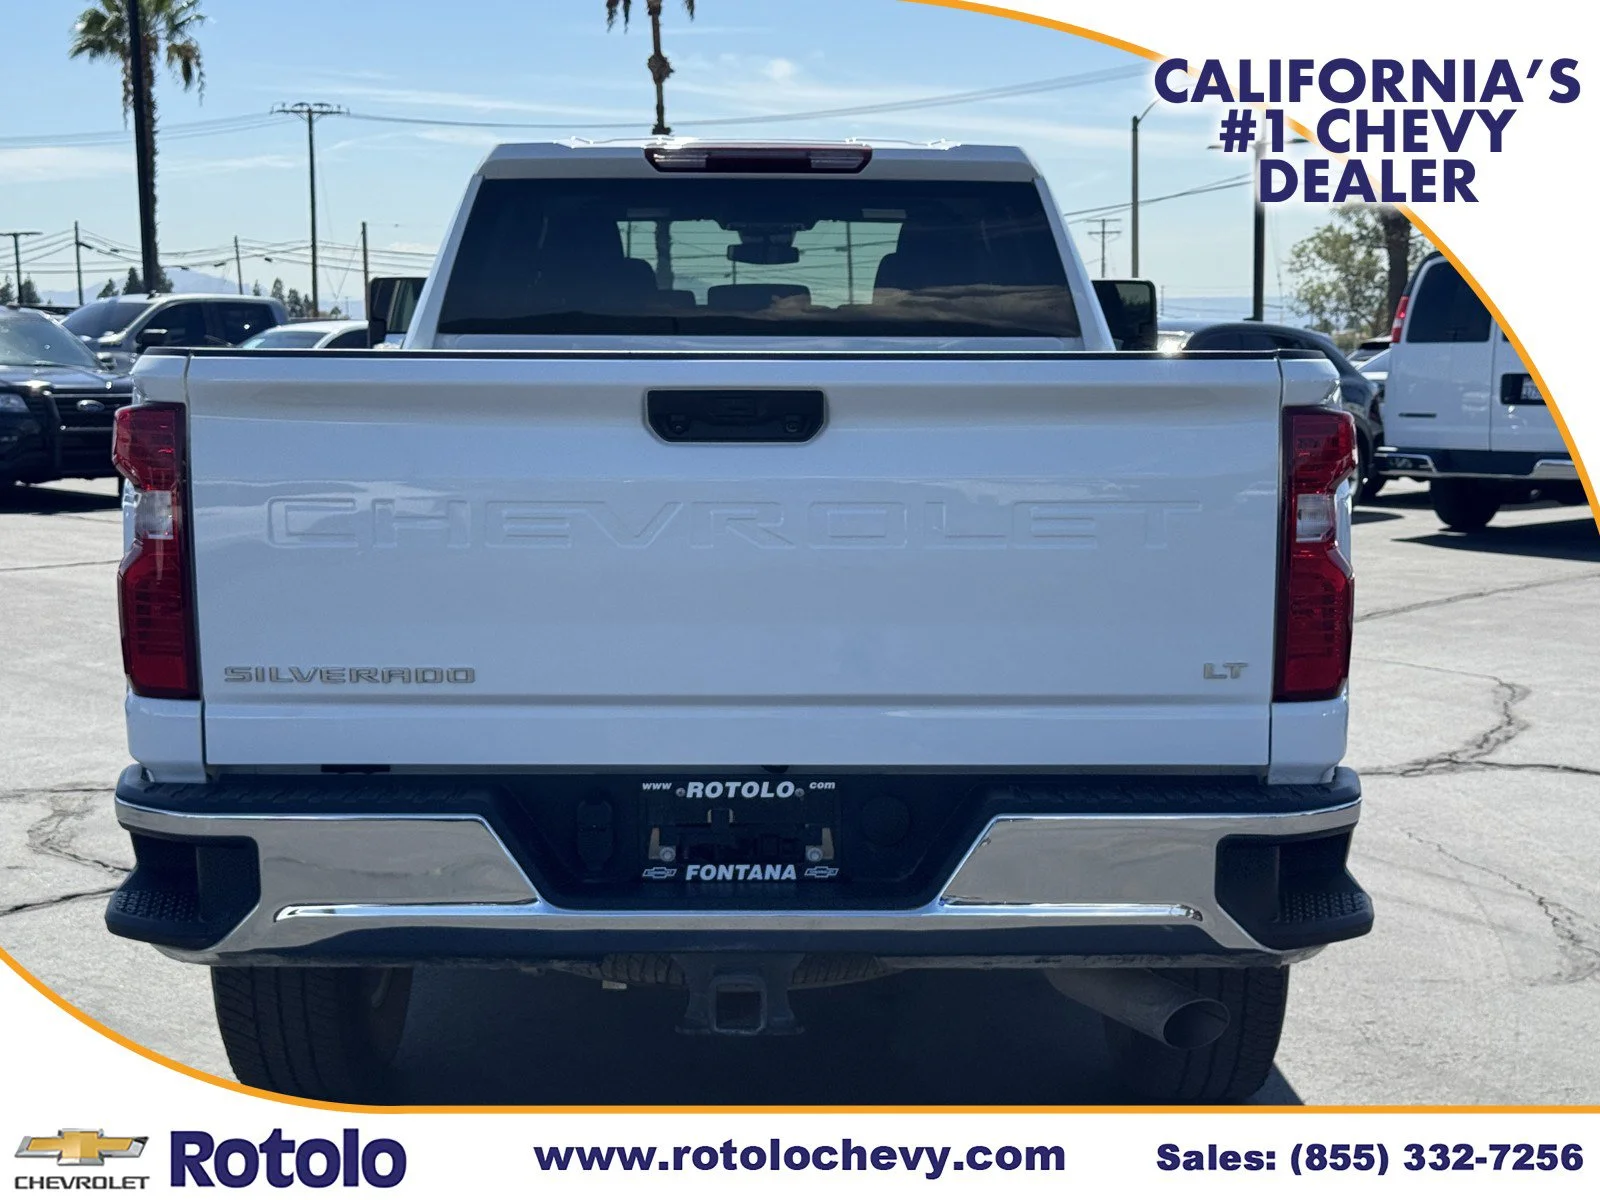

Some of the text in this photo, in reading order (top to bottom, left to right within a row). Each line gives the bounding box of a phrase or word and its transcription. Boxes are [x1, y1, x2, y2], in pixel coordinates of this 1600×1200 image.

[267, 498, 1202, 550] CHEVROLET
[223, 665, 477, 685] SILVERADO
[1203, 662, 1249, 680] LT
[642, 781, 836, 798] www ROTOLO com
[685, 864, 797, 881] FONTANA
